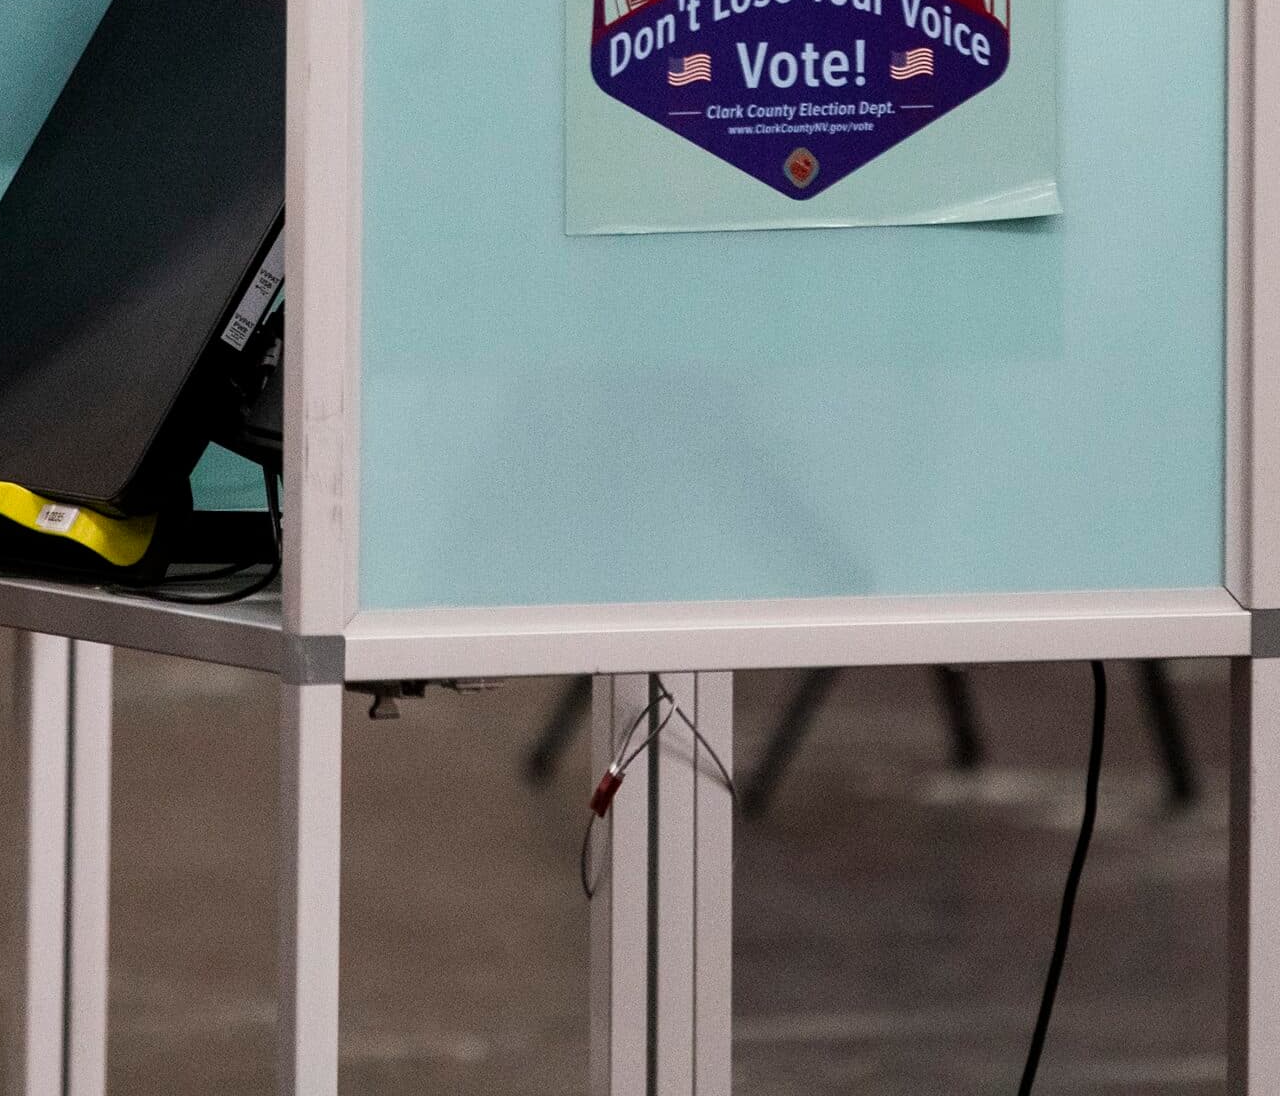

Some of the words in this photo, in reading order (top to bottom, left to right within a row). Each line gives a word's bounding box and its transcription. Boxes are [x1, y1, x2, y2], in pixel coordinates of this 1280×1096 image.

[736, 39, 866, 89] Vote!
[706, 105, 744, 119] Clark
[747, 104, 796, 121] County
[799, 102, 856, 117] Election
[859, 101, 896, 118] Dept.
[727, 121, 875, 135] www.ClarkCountyNV.gov/vote
